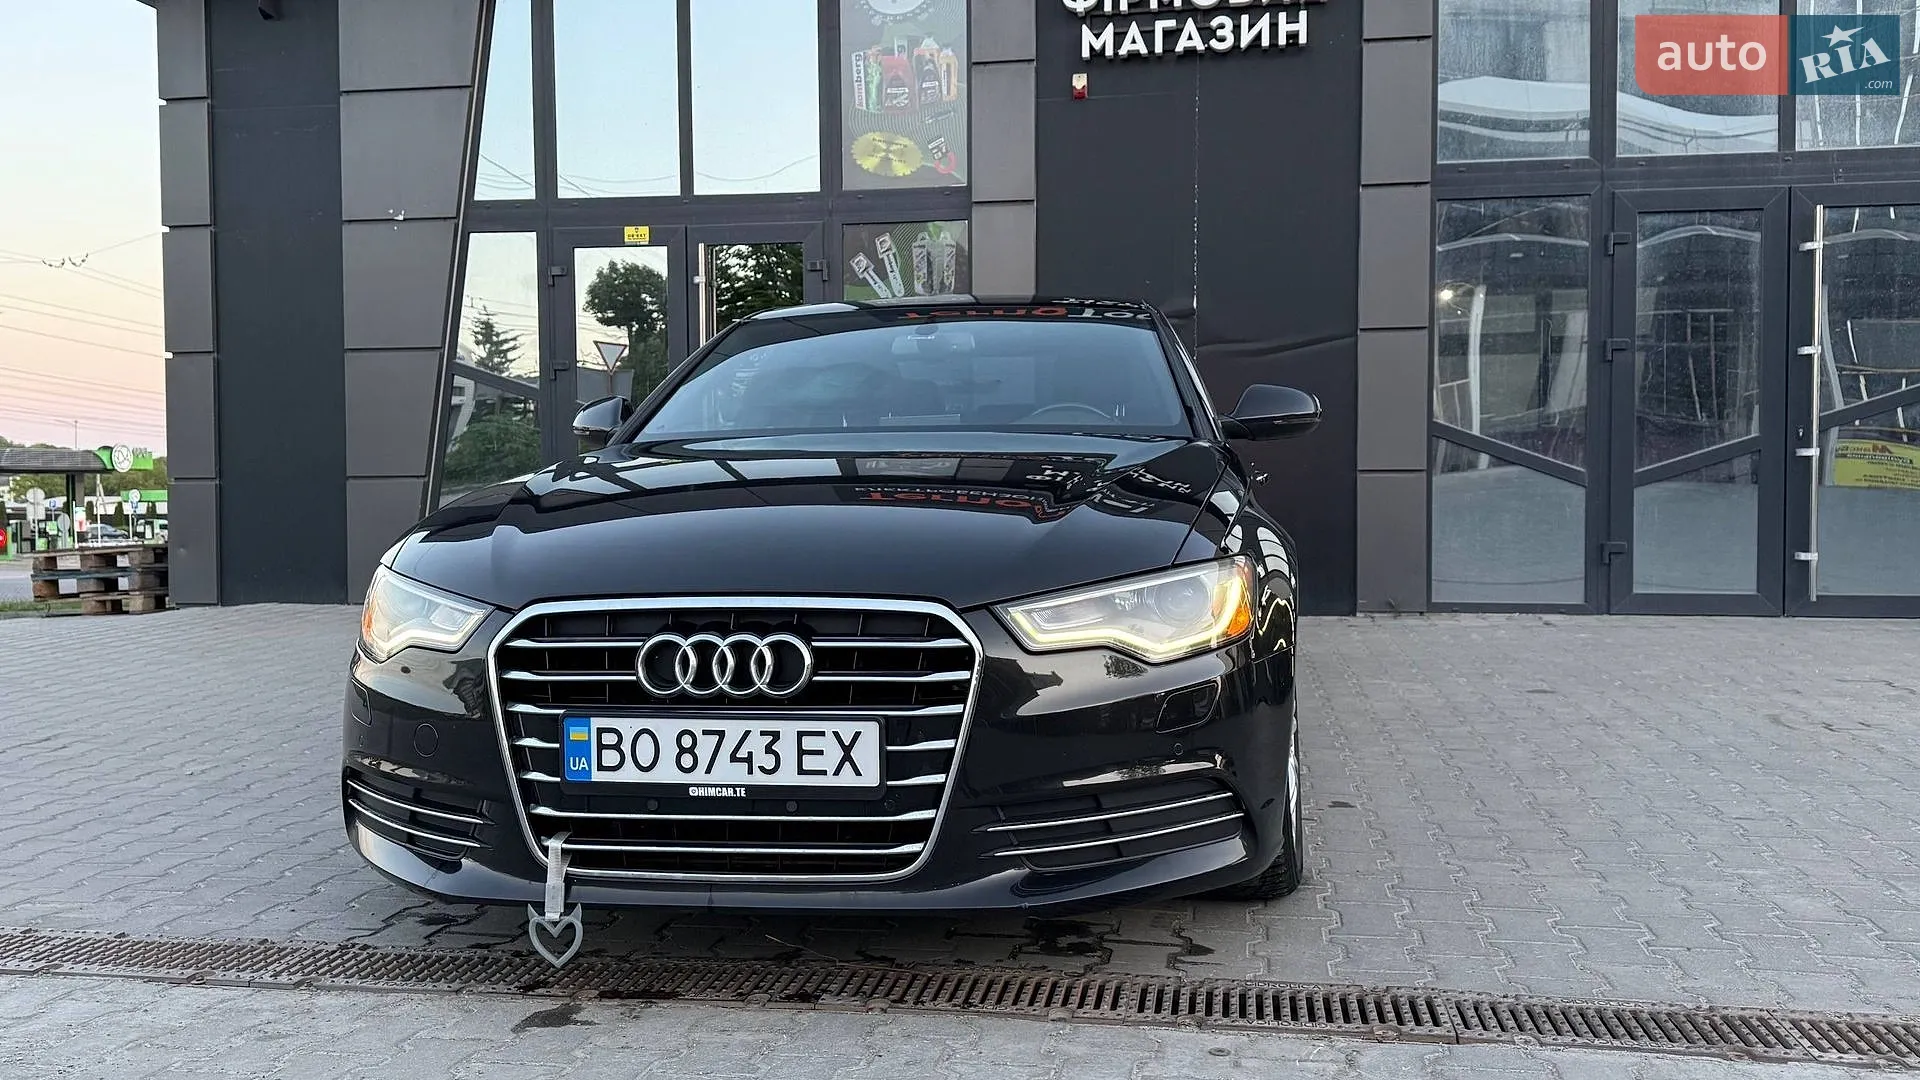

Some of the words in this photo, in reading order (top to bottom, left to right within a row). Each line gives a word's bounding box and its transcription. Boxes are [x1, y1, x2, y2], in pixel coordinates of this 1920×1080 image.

[1081, 10, 1308, 60] МАГАЗИН
[570, 757, 588, 771] UA
[596, 727, 661, 773] BO
[675, 728, 781, 775] 8743
[796, 730, 863, 777] EX
